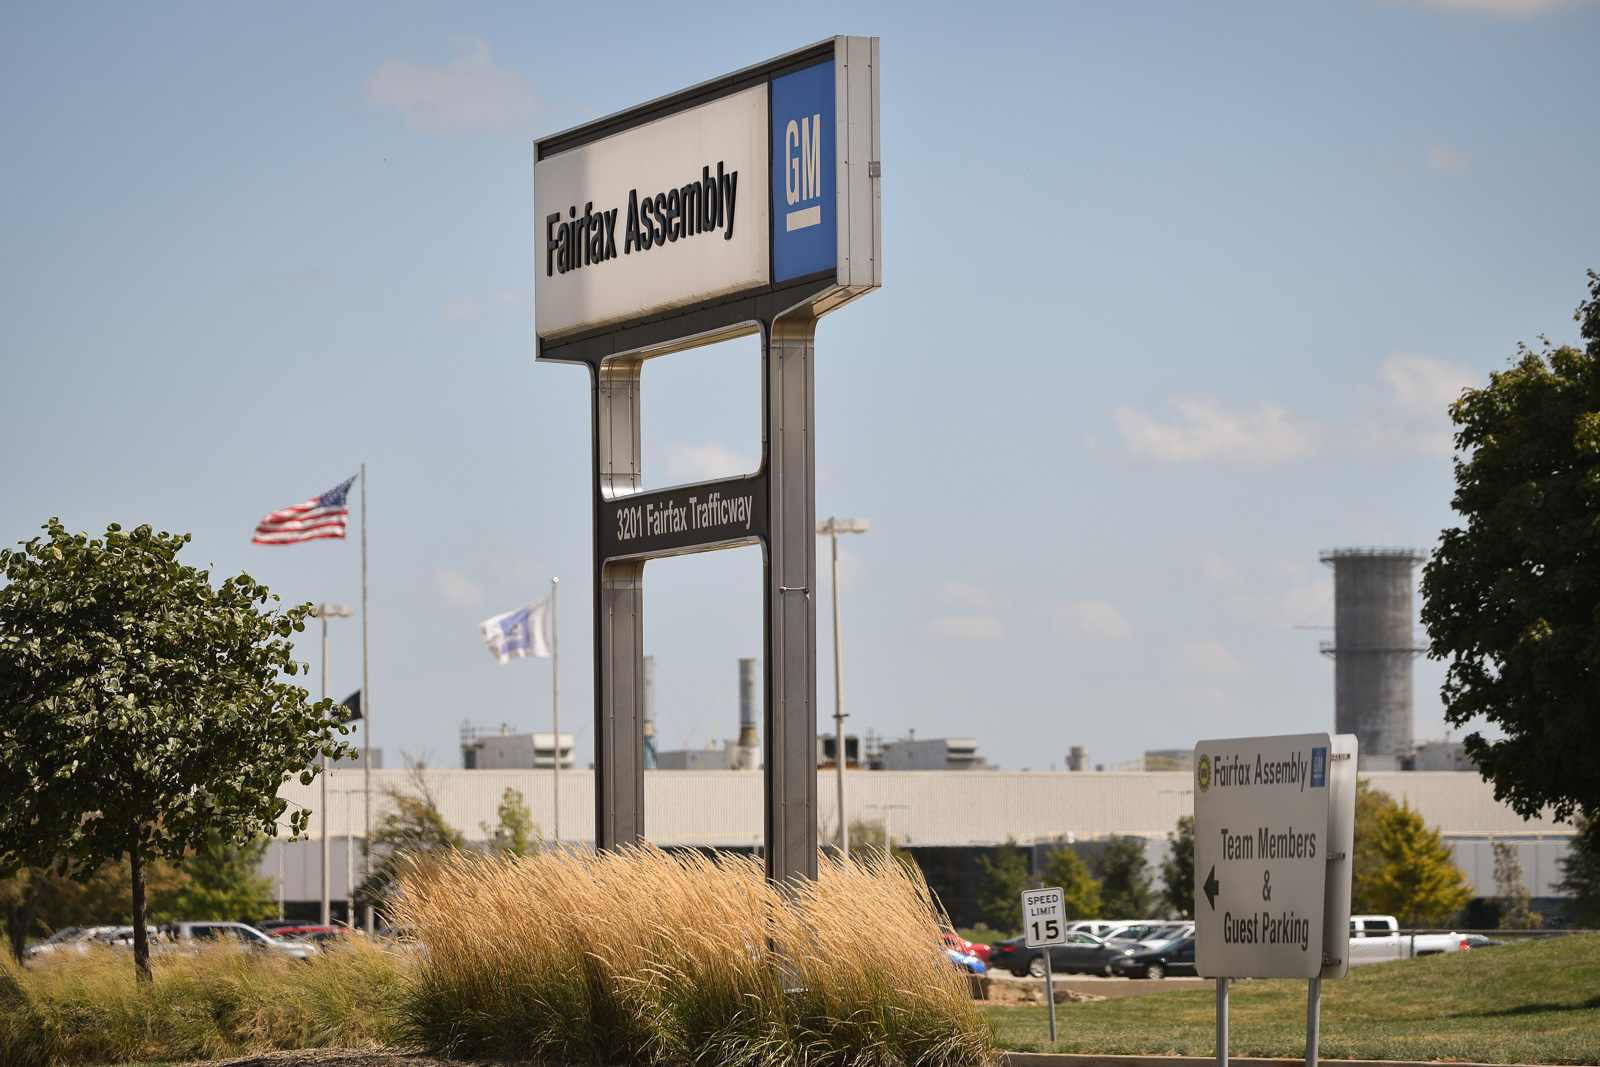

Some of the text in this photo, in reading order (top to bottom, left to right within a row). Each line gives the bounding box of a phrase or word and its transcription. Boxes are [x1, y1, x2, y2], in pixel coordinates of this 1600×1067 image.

[785, 113, 821, 206] GM
[546, 161, 738, 277] Fairfax Assembly
[616, 492, 753, 541] 3201 Fairfax Trafficway
[1213, 754, 1251, 787] Fairfax
[1254, 751, 1308, 792] Assembly
[1220, 826, 1316, 860] Team Members
[1027, 894, 1058, 905] SPEED
[1262, 869, 1272, 902] &
[1031, 906, 1056, 916] LIMIT
[1032, 920, 1059, 940] 15
[1223, 911, 1309, 951] Guest Parking
